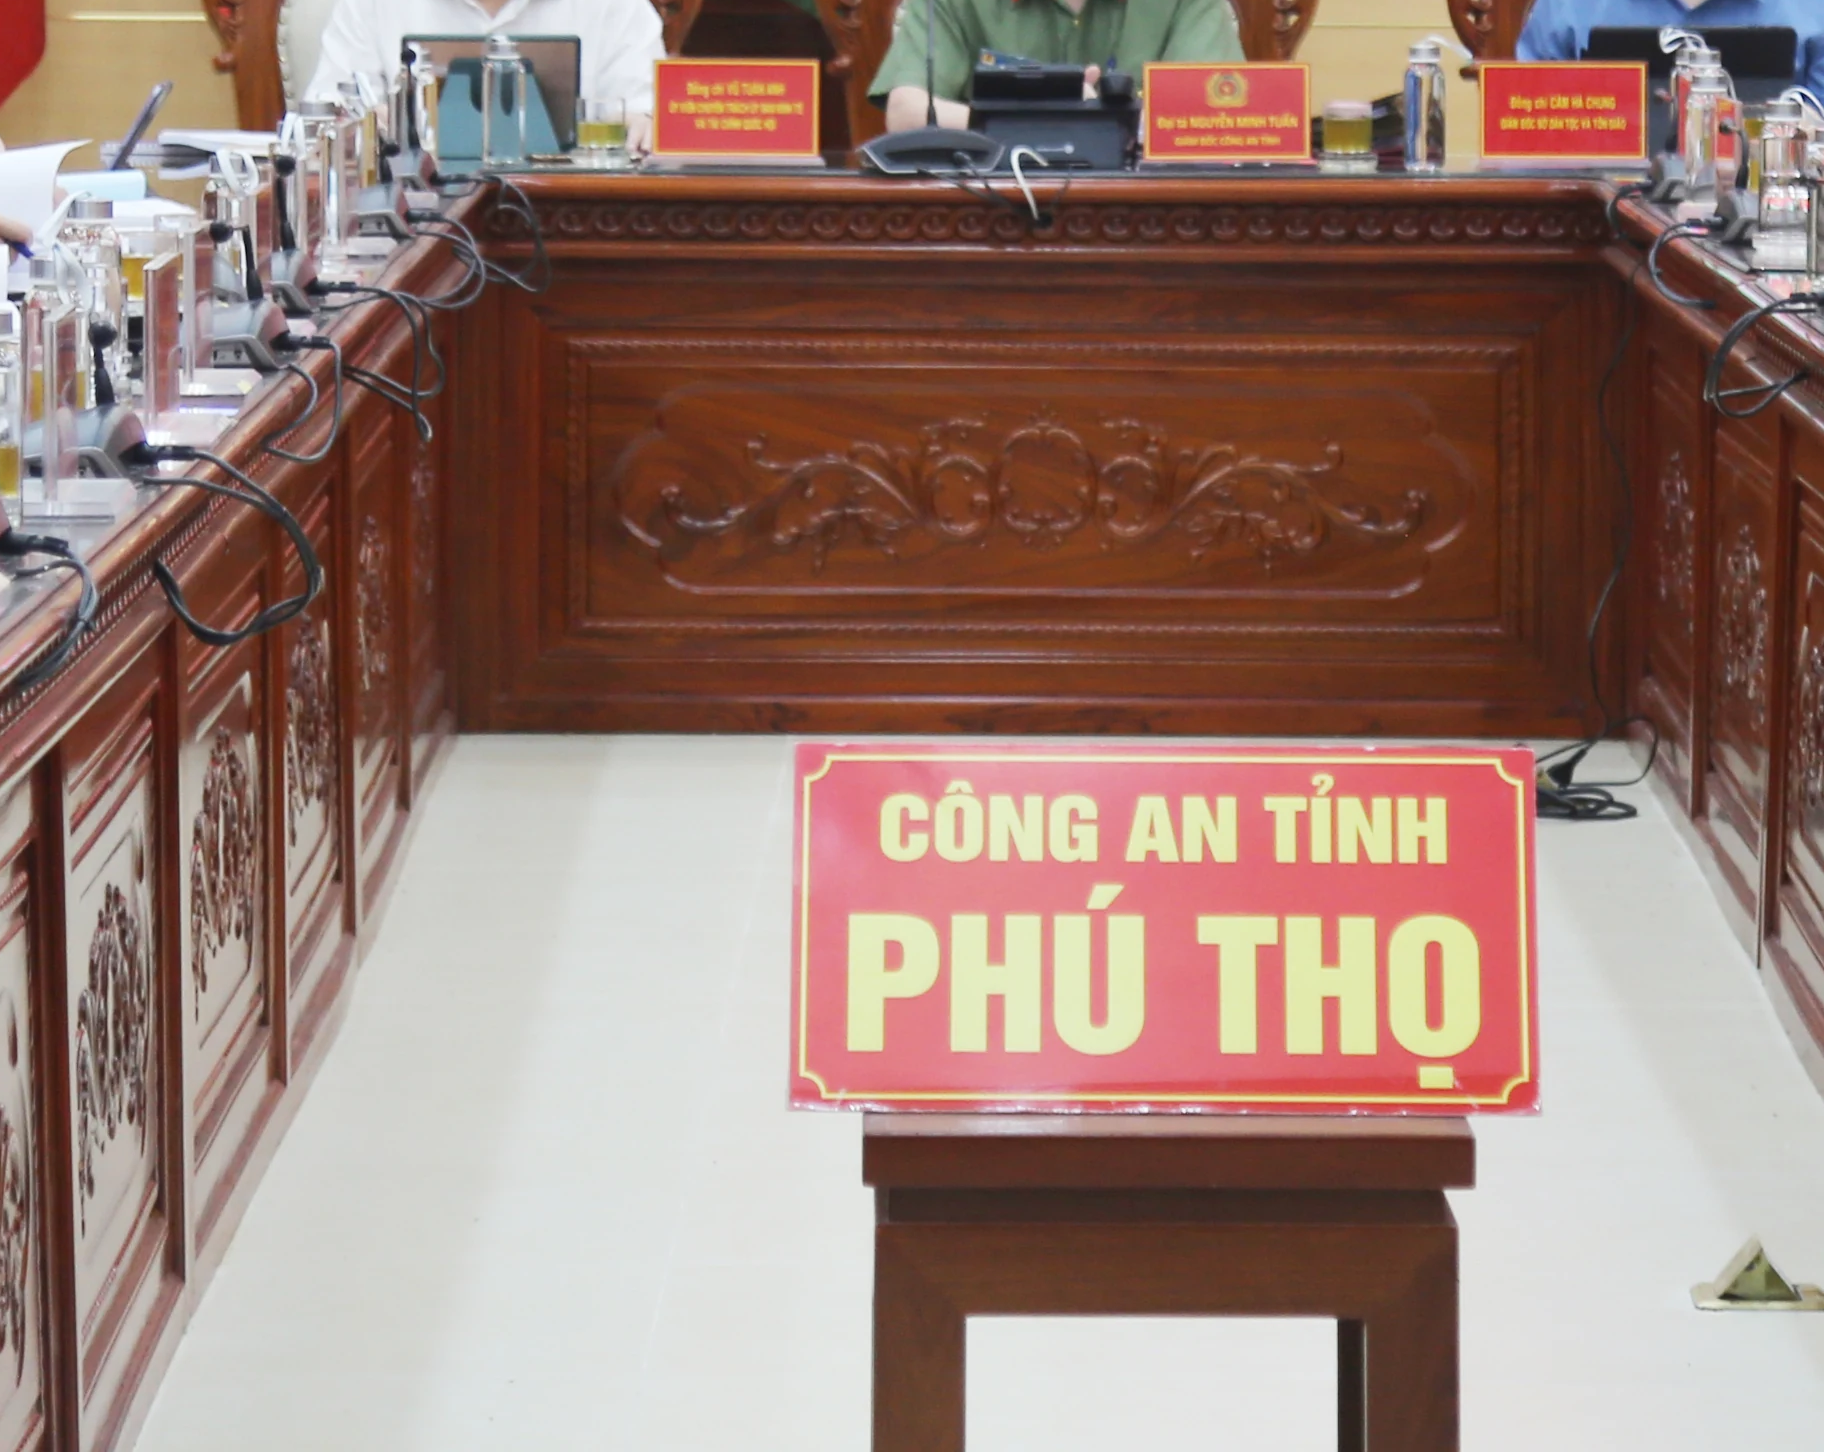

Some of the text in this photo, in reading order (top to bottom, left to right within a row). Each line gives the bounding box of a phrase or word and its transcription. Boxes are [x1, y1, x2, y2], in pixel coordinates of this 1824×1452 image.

[878, 773, 1450, 865] CÔNG AN TỈNH
[846, 884, 1483, 1090] PHÚ THỌ
